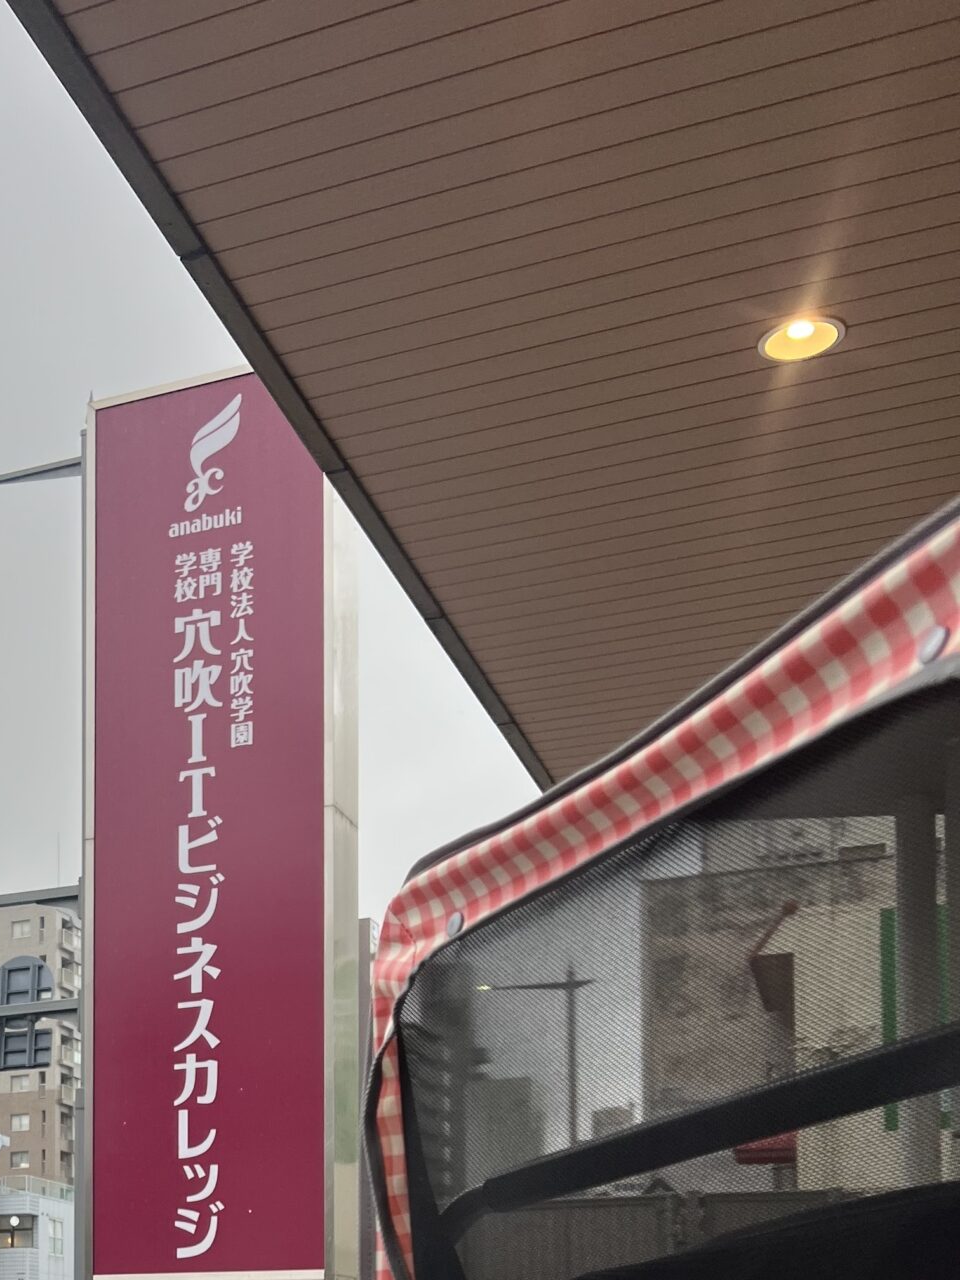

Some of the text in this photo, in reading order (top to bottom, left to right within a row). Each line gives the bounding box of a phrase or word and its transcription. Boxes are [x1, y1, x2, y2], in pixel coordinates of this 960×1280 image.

[168, 506, 242, 538] anabuki
[230, 541, 254, 748] 学校法人穴吹学園
[173, 608, 226, 1259] 穴吹ITビジネスカレッジ
